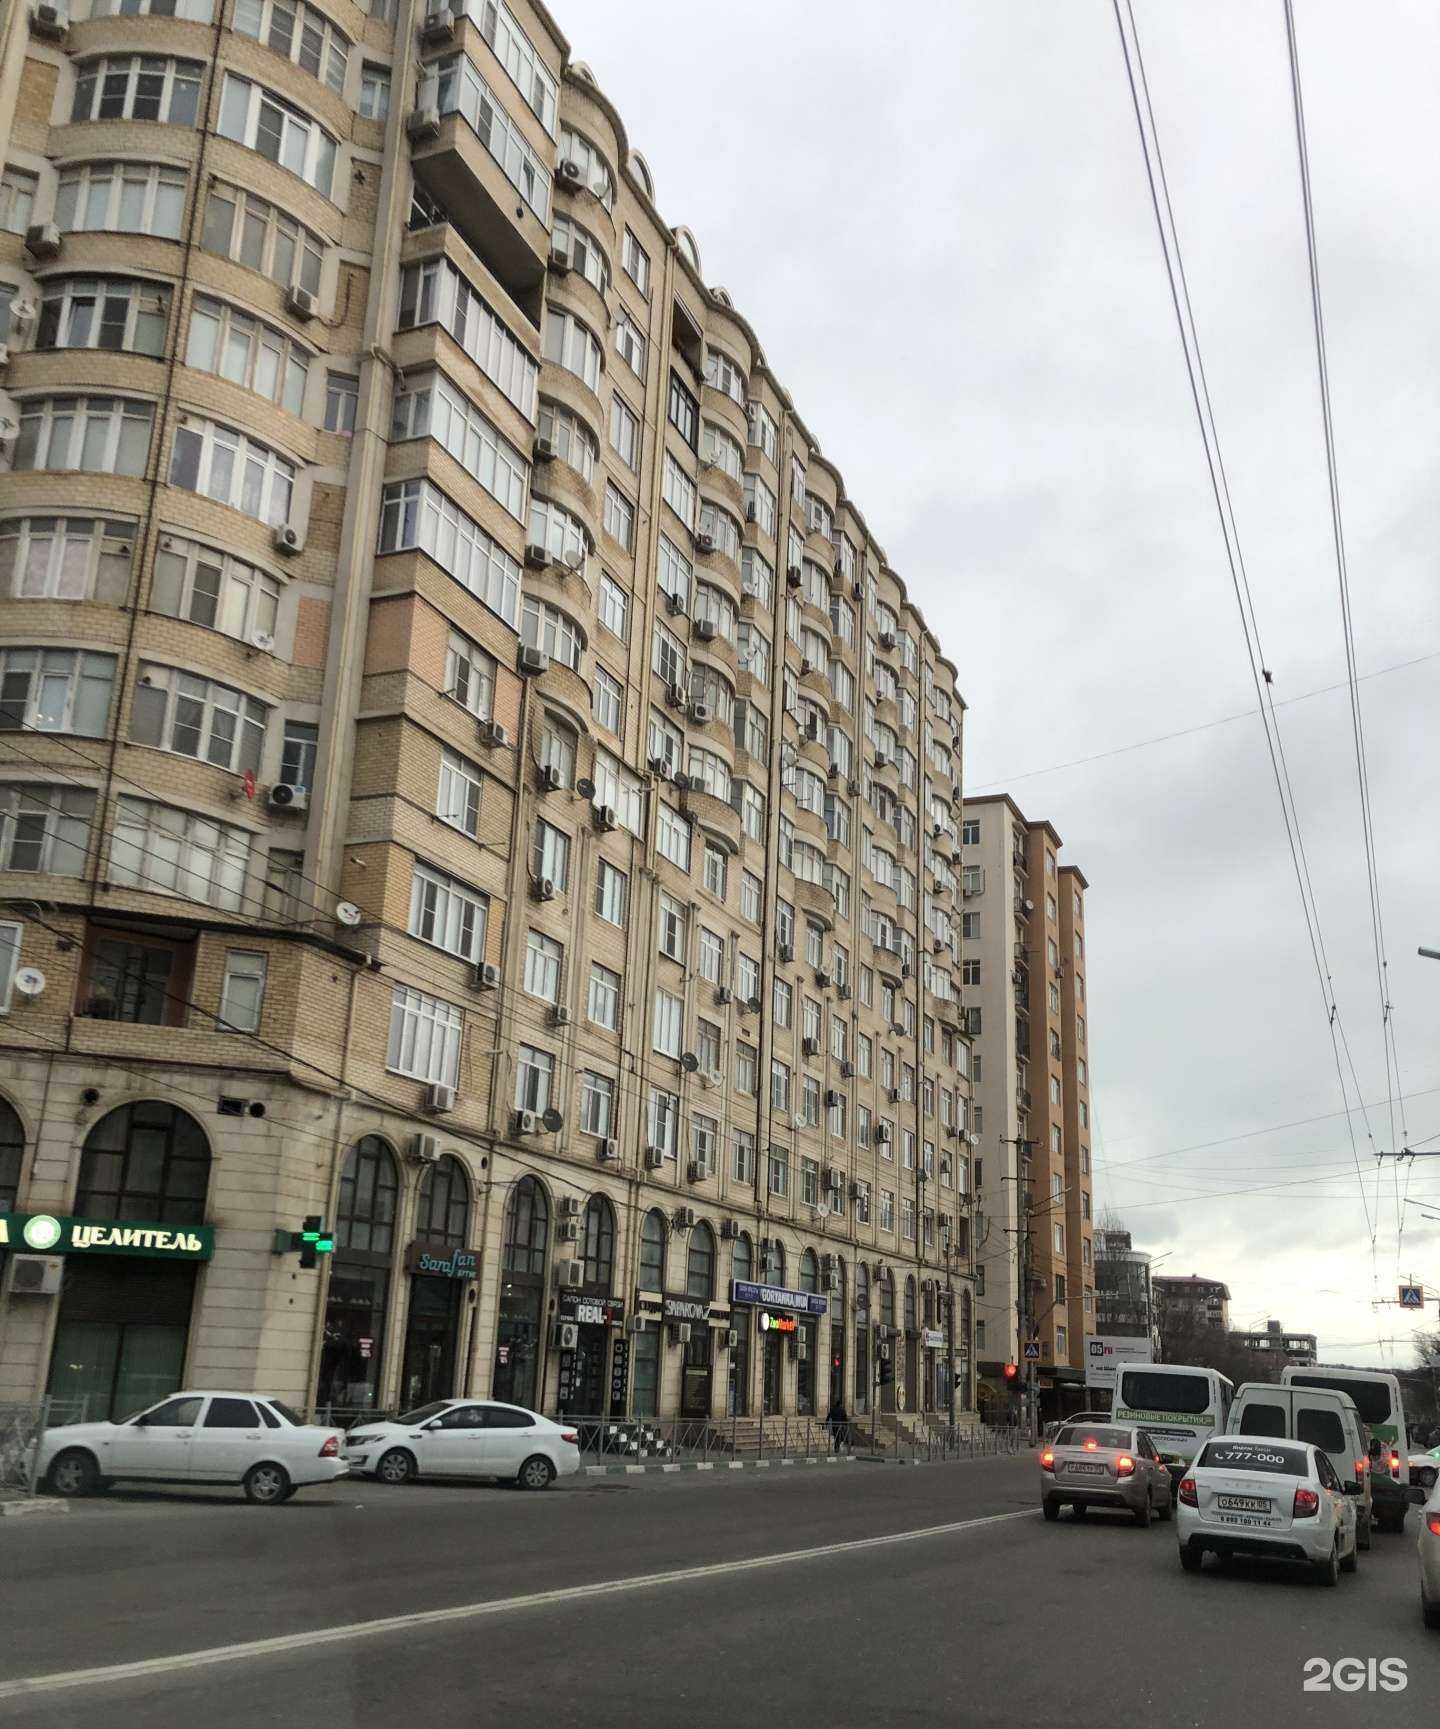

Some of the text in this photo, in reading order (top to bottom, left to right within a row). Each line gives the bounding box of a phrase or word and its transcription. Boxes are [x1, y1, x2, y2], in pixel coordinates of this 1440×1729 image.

[71, 1225, 203, 1252] ЦЕЛИТЕЛЬ
[1117, 1409, 1204, 1425] РЕЗИНОВЫЕ ПОКРЫТИЯ
[1225, 1451, 1284, 1464] 777-000
